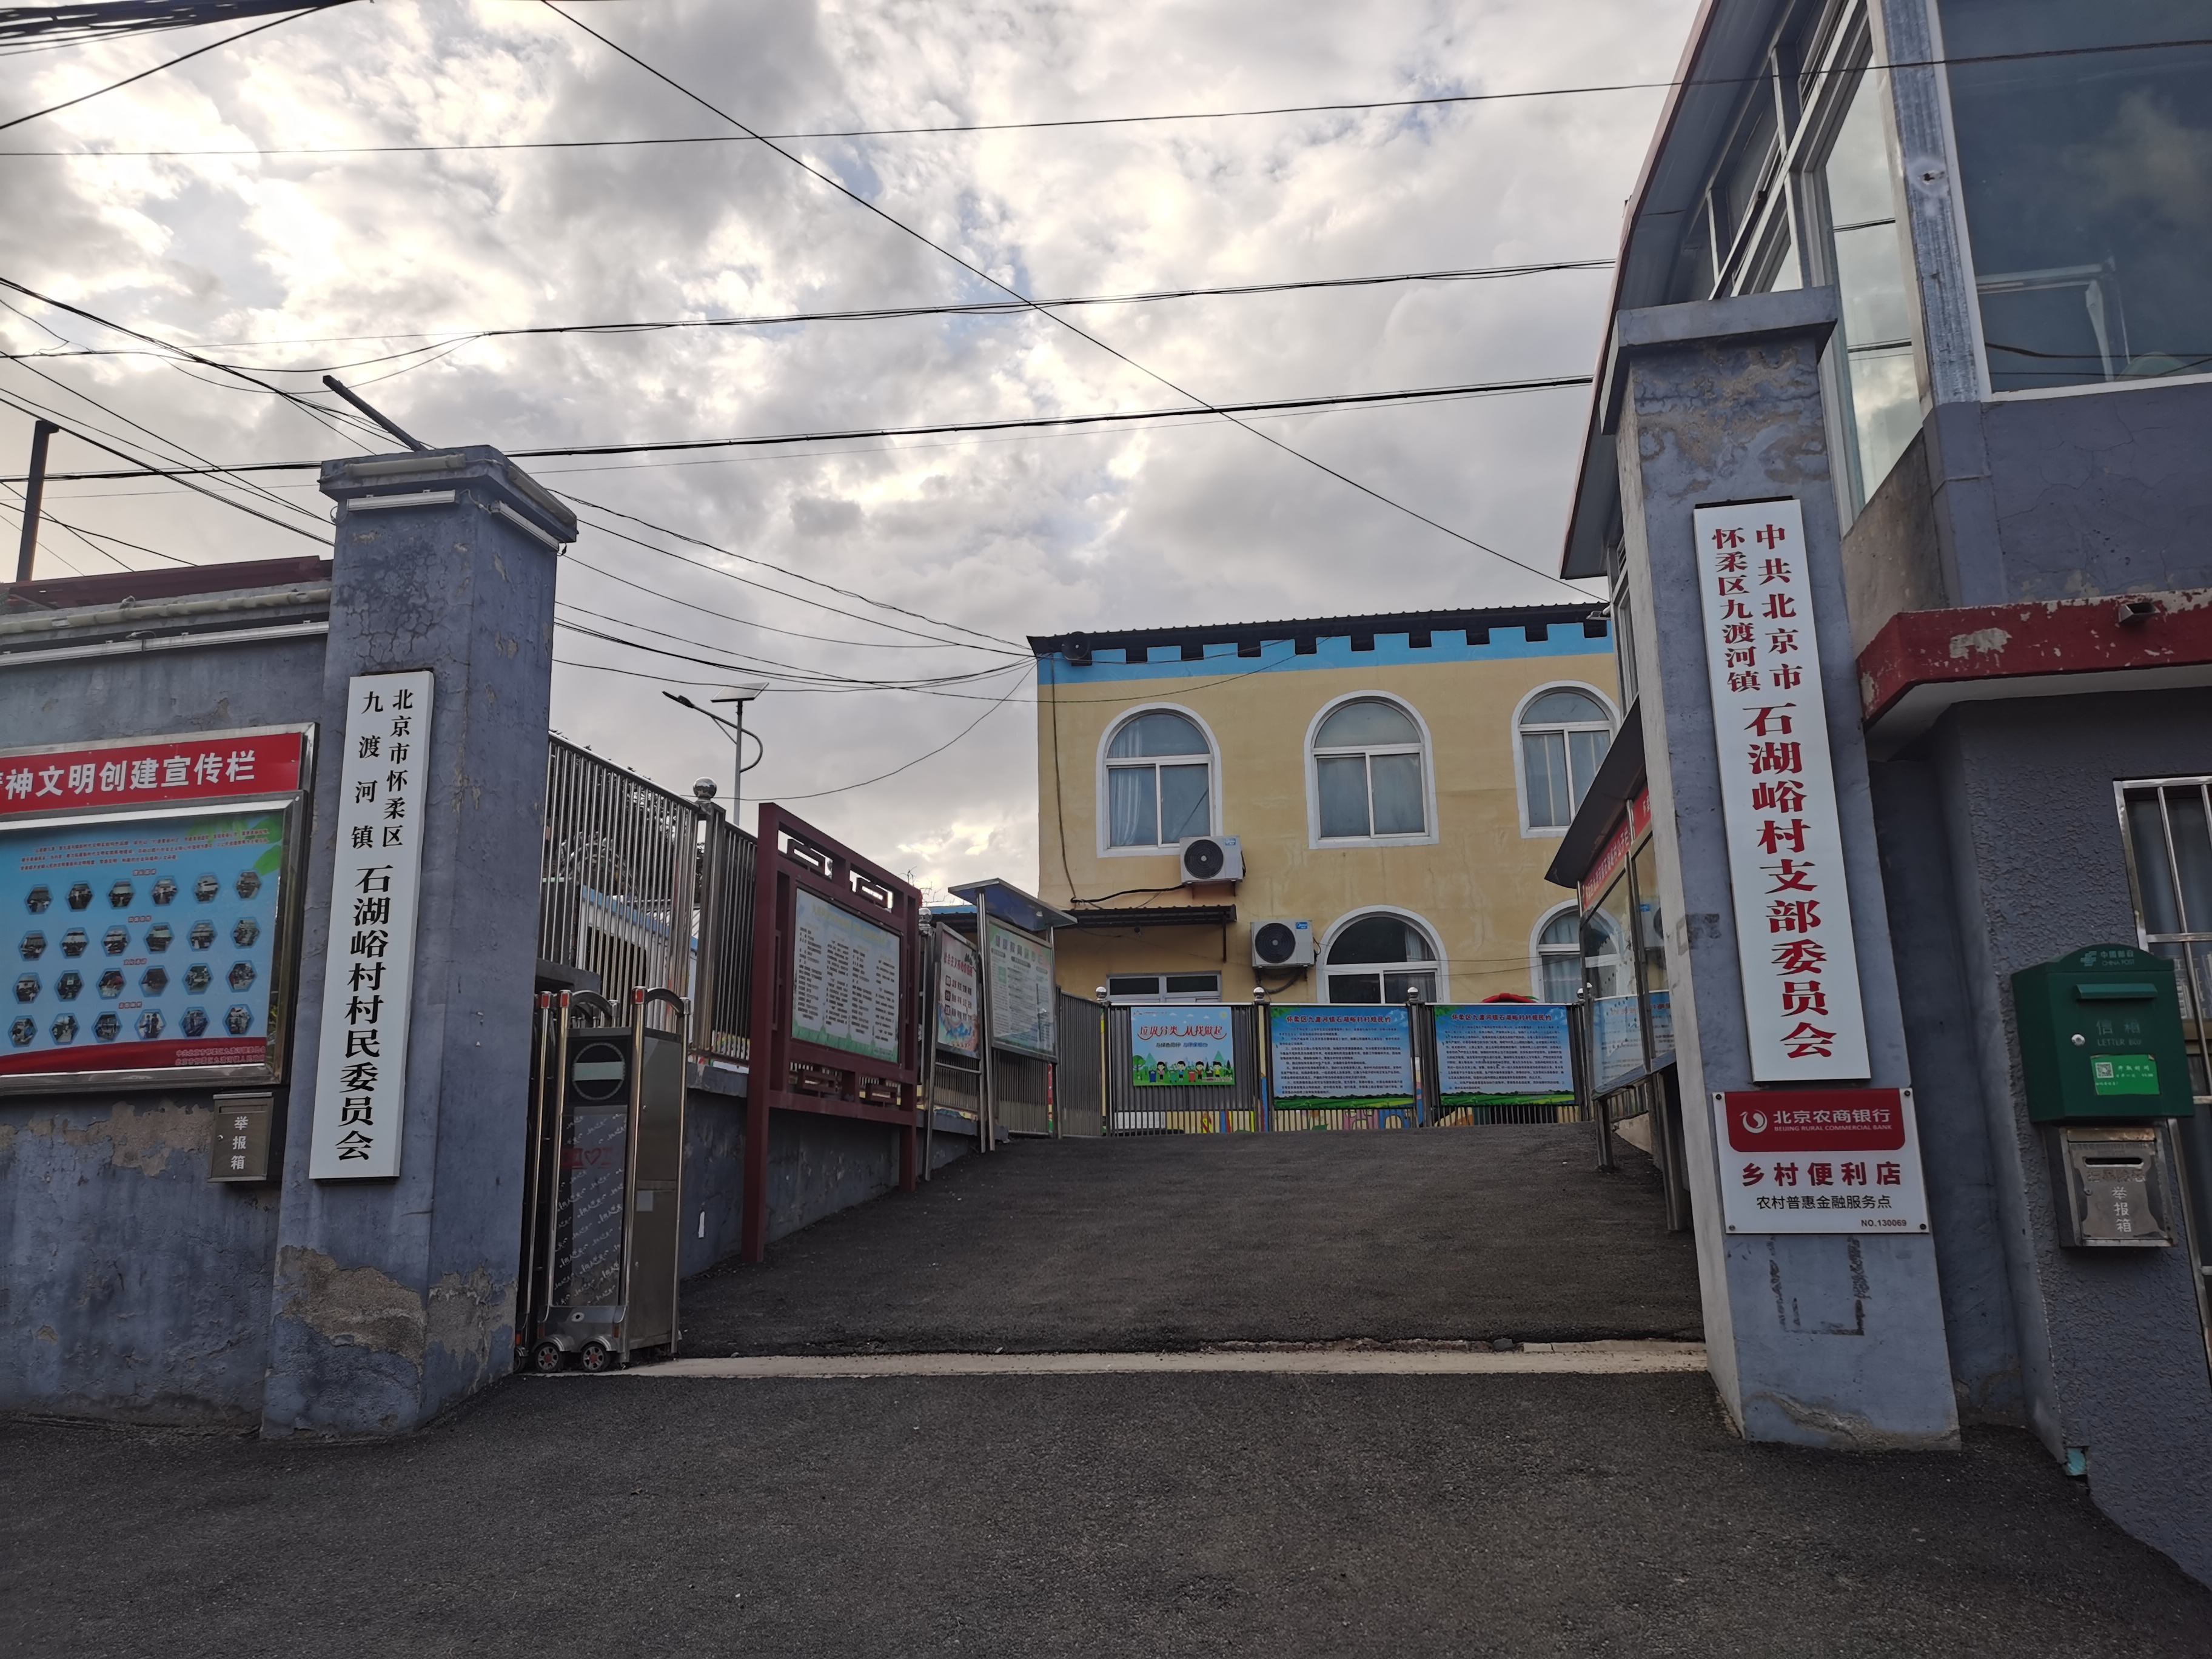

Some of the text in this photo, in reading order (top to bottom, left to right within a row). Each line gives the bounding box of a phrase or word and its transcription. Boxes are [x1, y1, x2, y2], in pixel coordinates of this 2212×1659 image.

[1712, 528, 1761, 692] 怀柔区九渡河镇
[1756, 524, 1803, 690] 中共北京市
[0, 749, 255, 800] 神文明创建宣传栏
[351, 691, 383, 850] 九渡河镇
[383, 689, 414, 847] 北京市怀柔区
[1743, 702, 1837, 1059] 石湖峪村支部委员会
[335, 865, 394, 1161] 石湖峪村村民委员会
[1139, 1025, 1225, 1037] 垃圾分类 从我做起
[2096, 1019, 2141, 1036] 信箱
[1773, 1108, 1891, 1124] 北京农商银行
[230, 1116, 249, 1170] 举报箱
[1742, 1161, 1902, 1187] 乡村便利店
[1756, 1195, 1892, 1210] 农村普惠金融服务点
[1861, 1219, 1908, 1227] NO.130069
[2111, 1187, 2132, 1233] 举报箱
